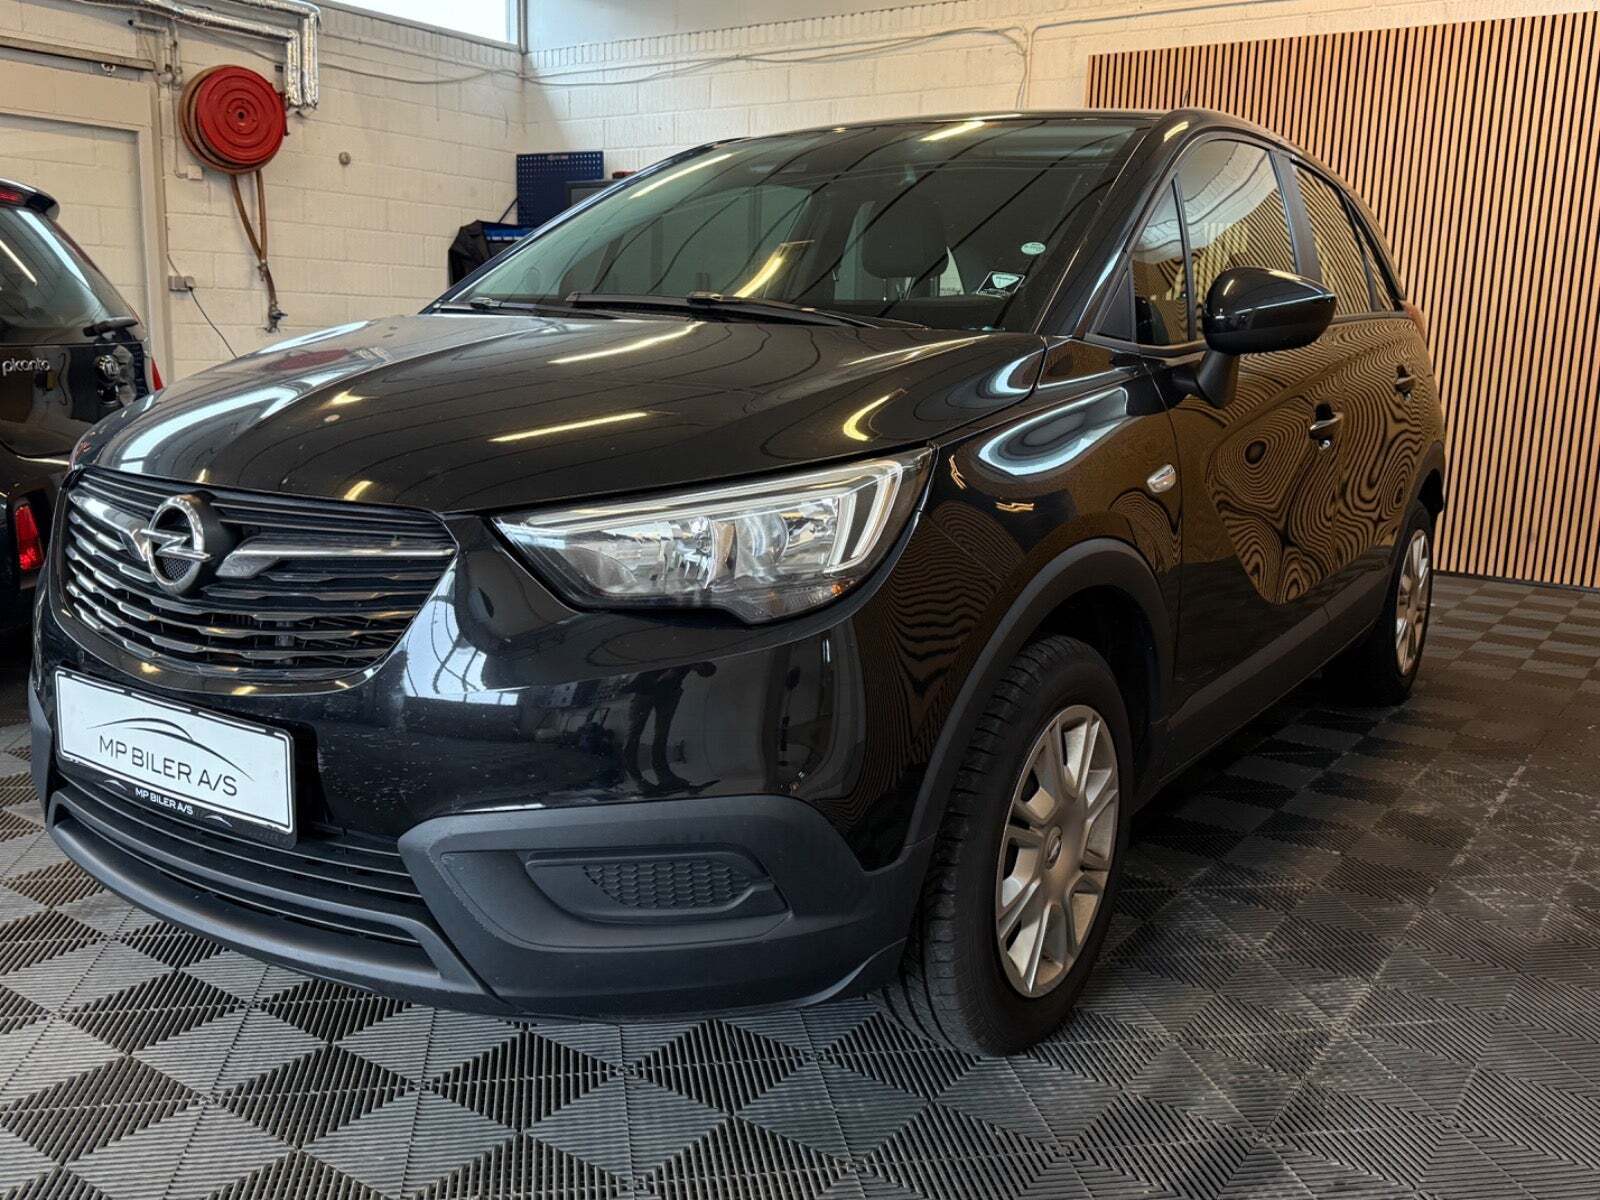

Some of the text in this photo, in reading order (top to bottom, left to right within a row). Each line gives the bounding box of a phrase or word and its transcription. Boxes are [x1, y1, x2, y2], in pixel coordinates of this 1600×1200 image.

[2, 357, 50, 376] picanto
[99, 735, 238, 797] MP BILER A/S
[135, 788, 194, 816] MP BILER A/S
